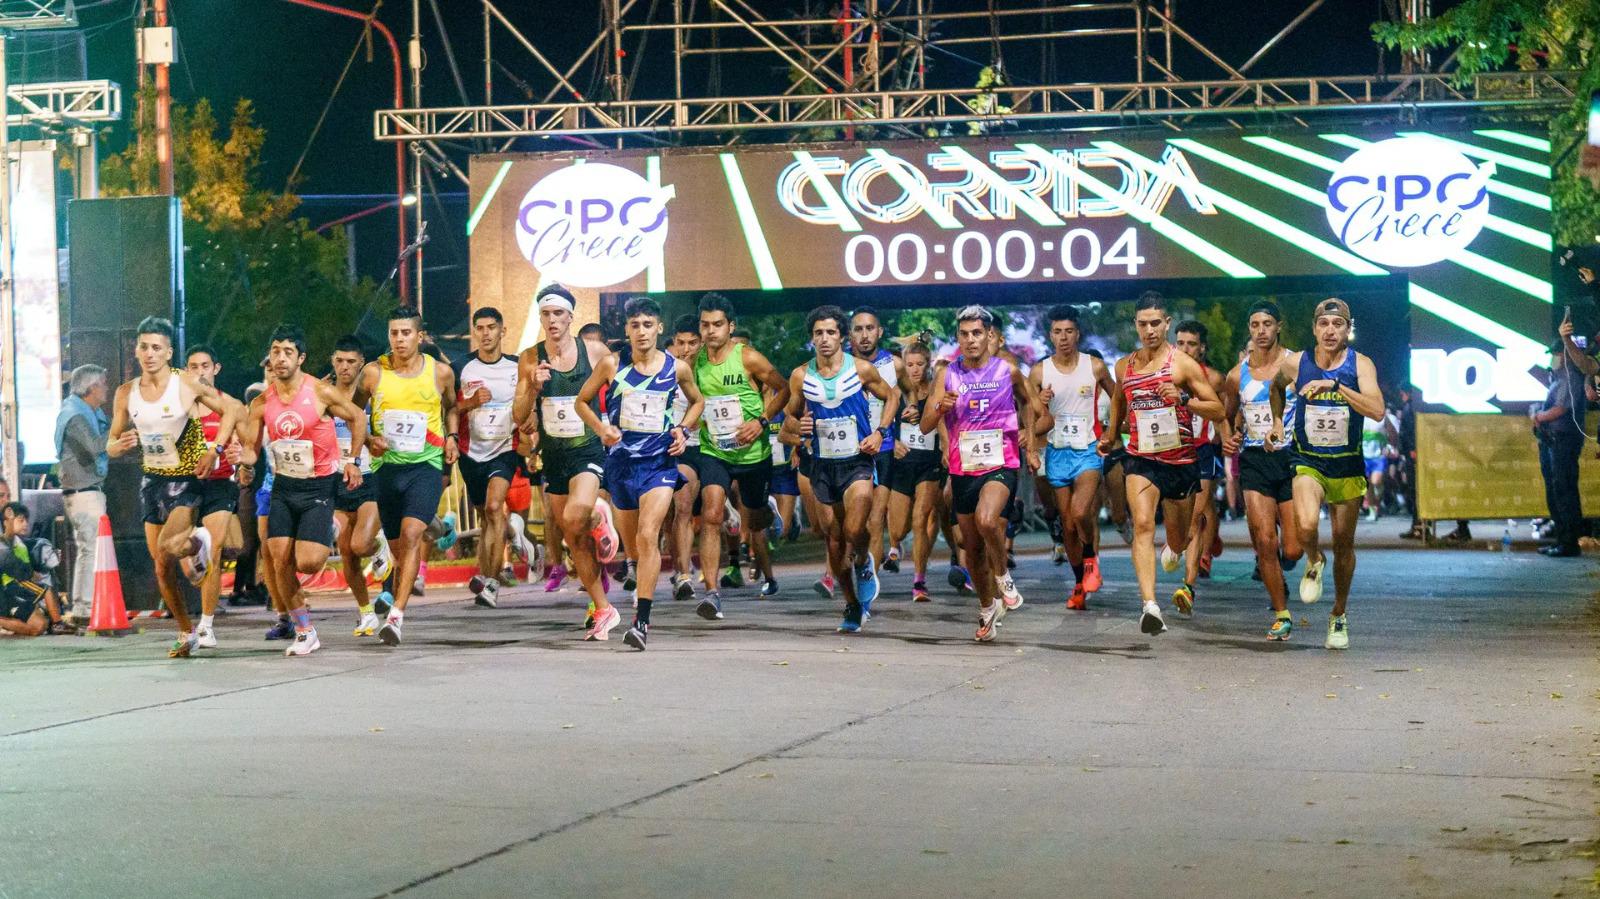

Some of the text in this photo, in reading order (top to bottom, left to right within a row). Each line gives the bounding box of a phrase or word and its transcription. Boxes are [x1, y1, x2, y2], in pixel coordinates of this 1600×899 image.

[777, 146, 1217, 225] CORRIDA
[1327, 172, 1487, 213] CIPO
[518, 197, 666, 235] CIPO
[844, 228, 1145, 283] 00:00:04
[723, 374, 743, 386] NLA
[969, 382, 1000, 390] PATAGONIA
[641, 403, 648, 414] 1
[713, 407, 729, 418] 18
[489, 414, 497, 425] 7
[557, 410, 565, 420] 6
[1254, 412, 1272, 424] 24
[395, 423, 415, 434] 27
[1062, 424, 1078, 435] 43
[1151, 423, 1160, 434] 9
[1317, 418, 1337, 431] 32
[827, 430, 847, 442] 49
[909, 434, 925, 444] 56
[971, 442, 992, 455] 45
[283, 451, 301, 462] 36
